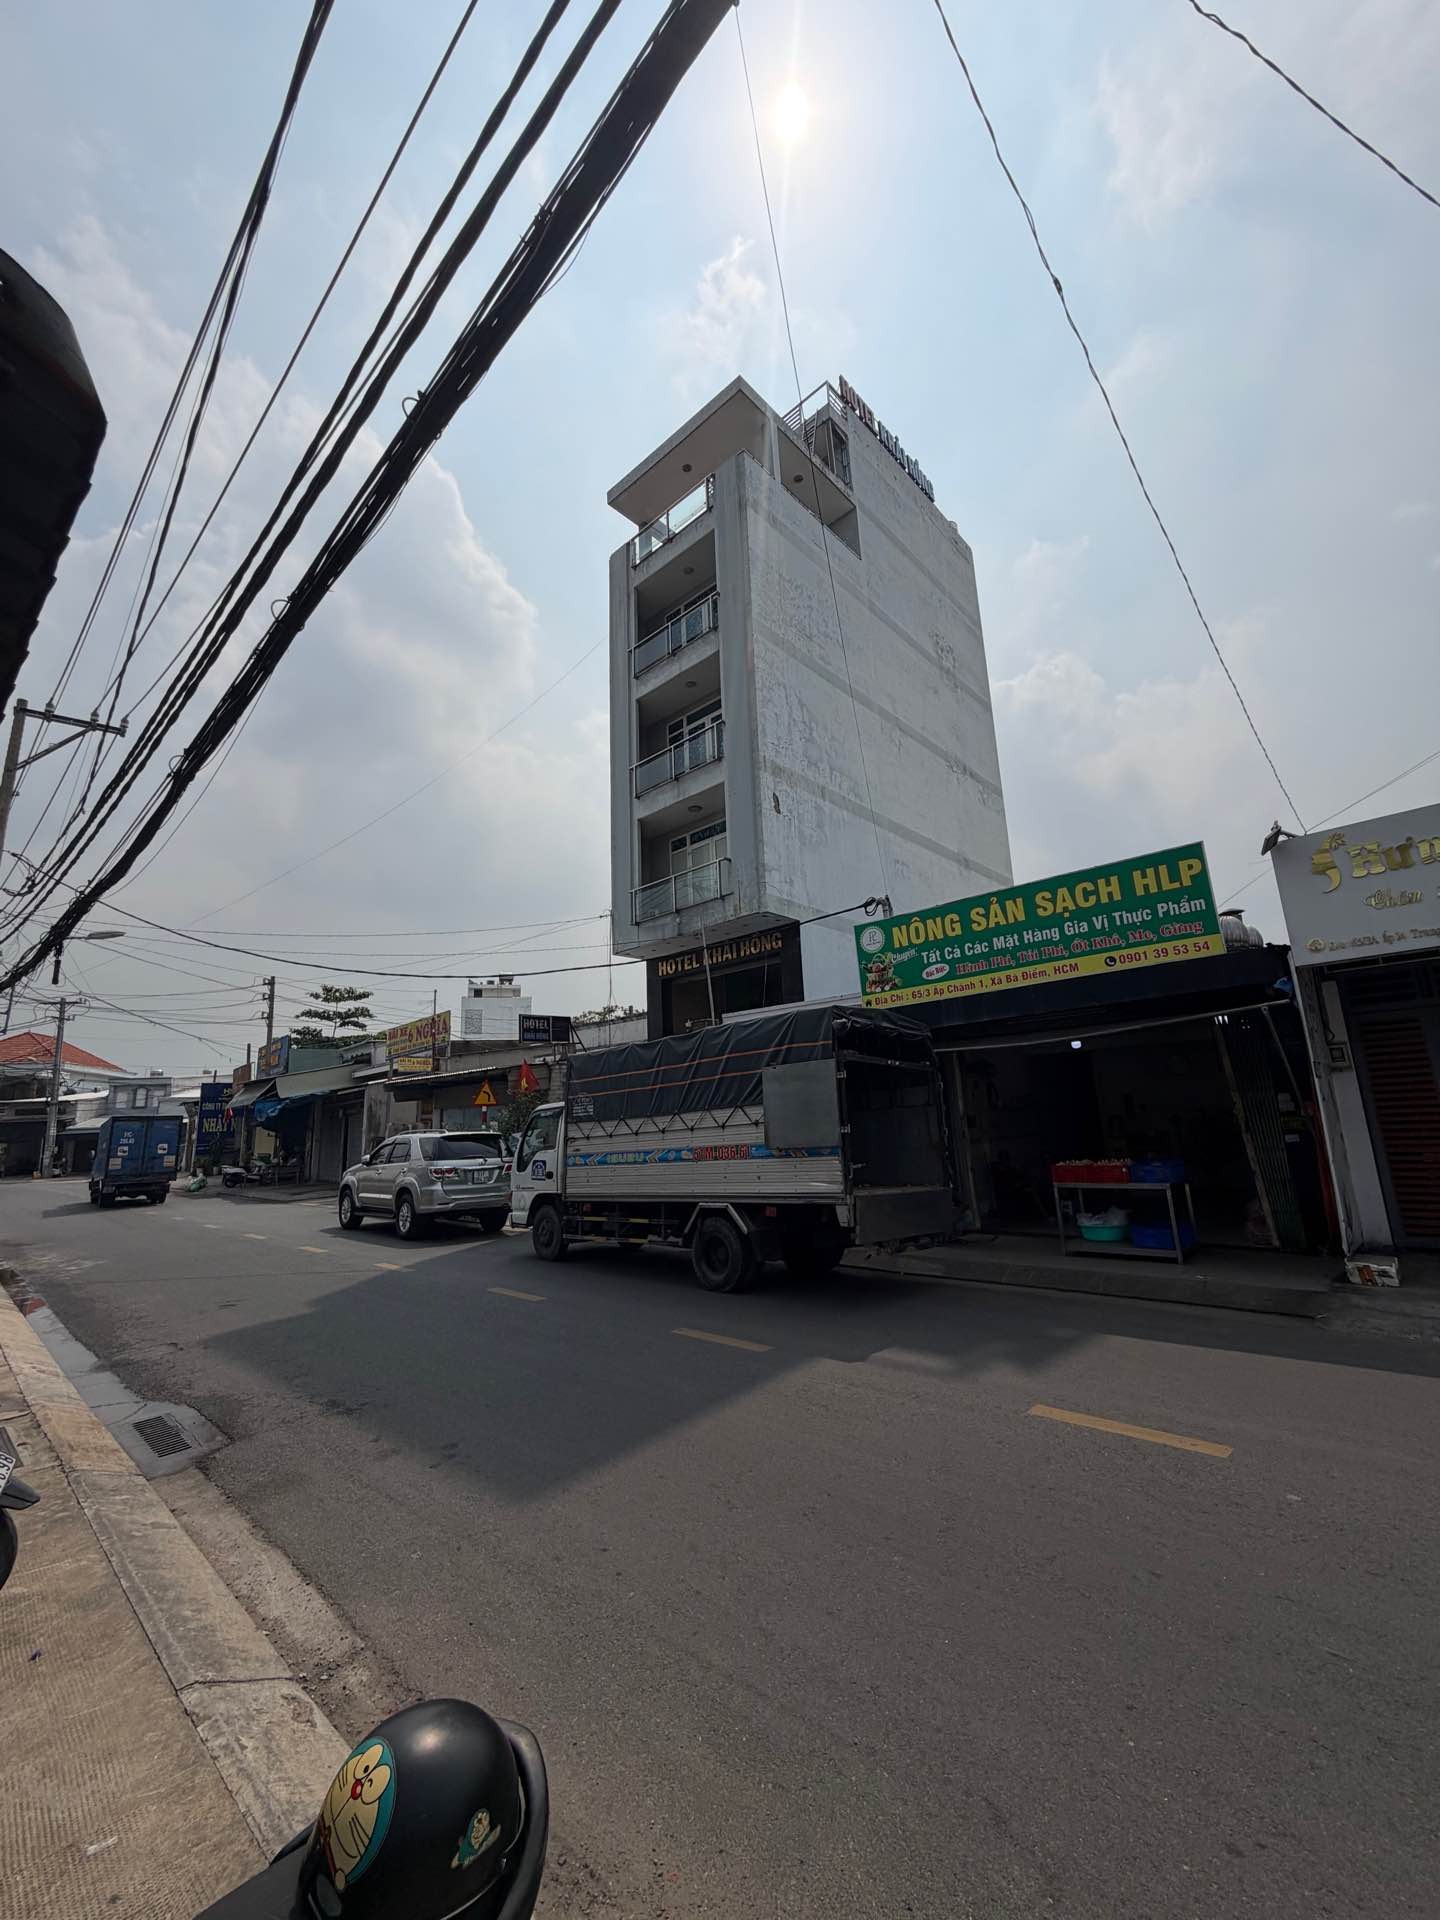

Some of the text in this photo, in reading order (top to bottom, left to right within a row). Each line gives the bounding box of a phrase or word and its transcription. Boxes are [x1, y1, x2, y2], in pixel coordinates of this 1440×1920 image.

[892, 916, 962, 948] NÔNG
[970, 896, 1026, 931] SẢN
[1036, 874, 1122, 918] SẠCH
[1133, 858, 1203, 896] HLP
[921, 895, 1206, 964] Tất Cả Các Mặt Hàng Gia Vị Thực Phẩm
[658, 952, 700, 976] HOTEL
[1119, 941, 1210, 965] 0901 39 53 54
[911, 988, 931, 999] 65/3
[1053, 962, 1079, 976] HCM
[523, 1018, 549, 1029] HOTEL
